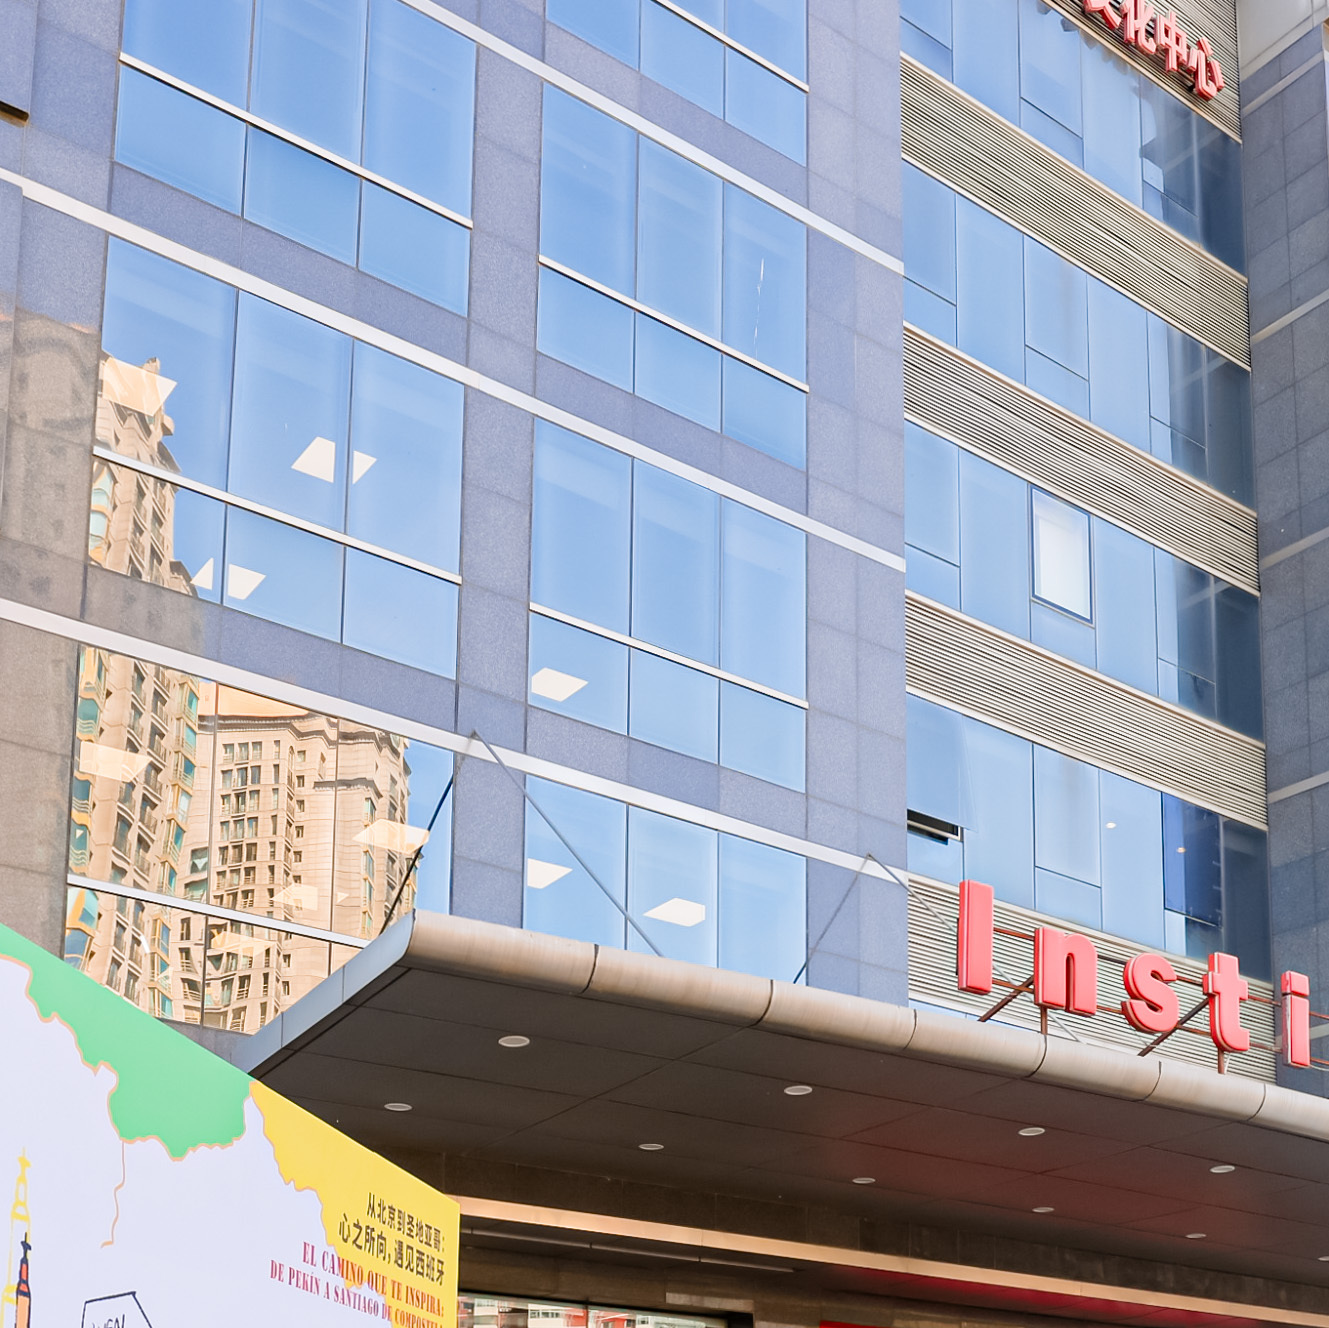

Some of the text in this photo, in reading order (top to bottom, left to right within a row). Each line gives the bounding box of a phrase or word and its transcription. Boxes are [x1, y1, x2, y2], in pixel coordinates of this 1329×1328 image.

[339, 1212, 445, 1286] 心之所向，遇见西班牙
[366, 1192, 445, 1253] 从北京到圣地亚哥：
[270, 1259, 285, 1282] DE
[288, 1266, 320, 1296] PEKÍN
[323, 1281, 331, 1300] A
[333, 1286, 379, 1317] SANTIAGO
[382, 1304, 392, 1322] DE
[302, 1242, 444, 1318] EL CAMINO QUE TE INSPIRA:
